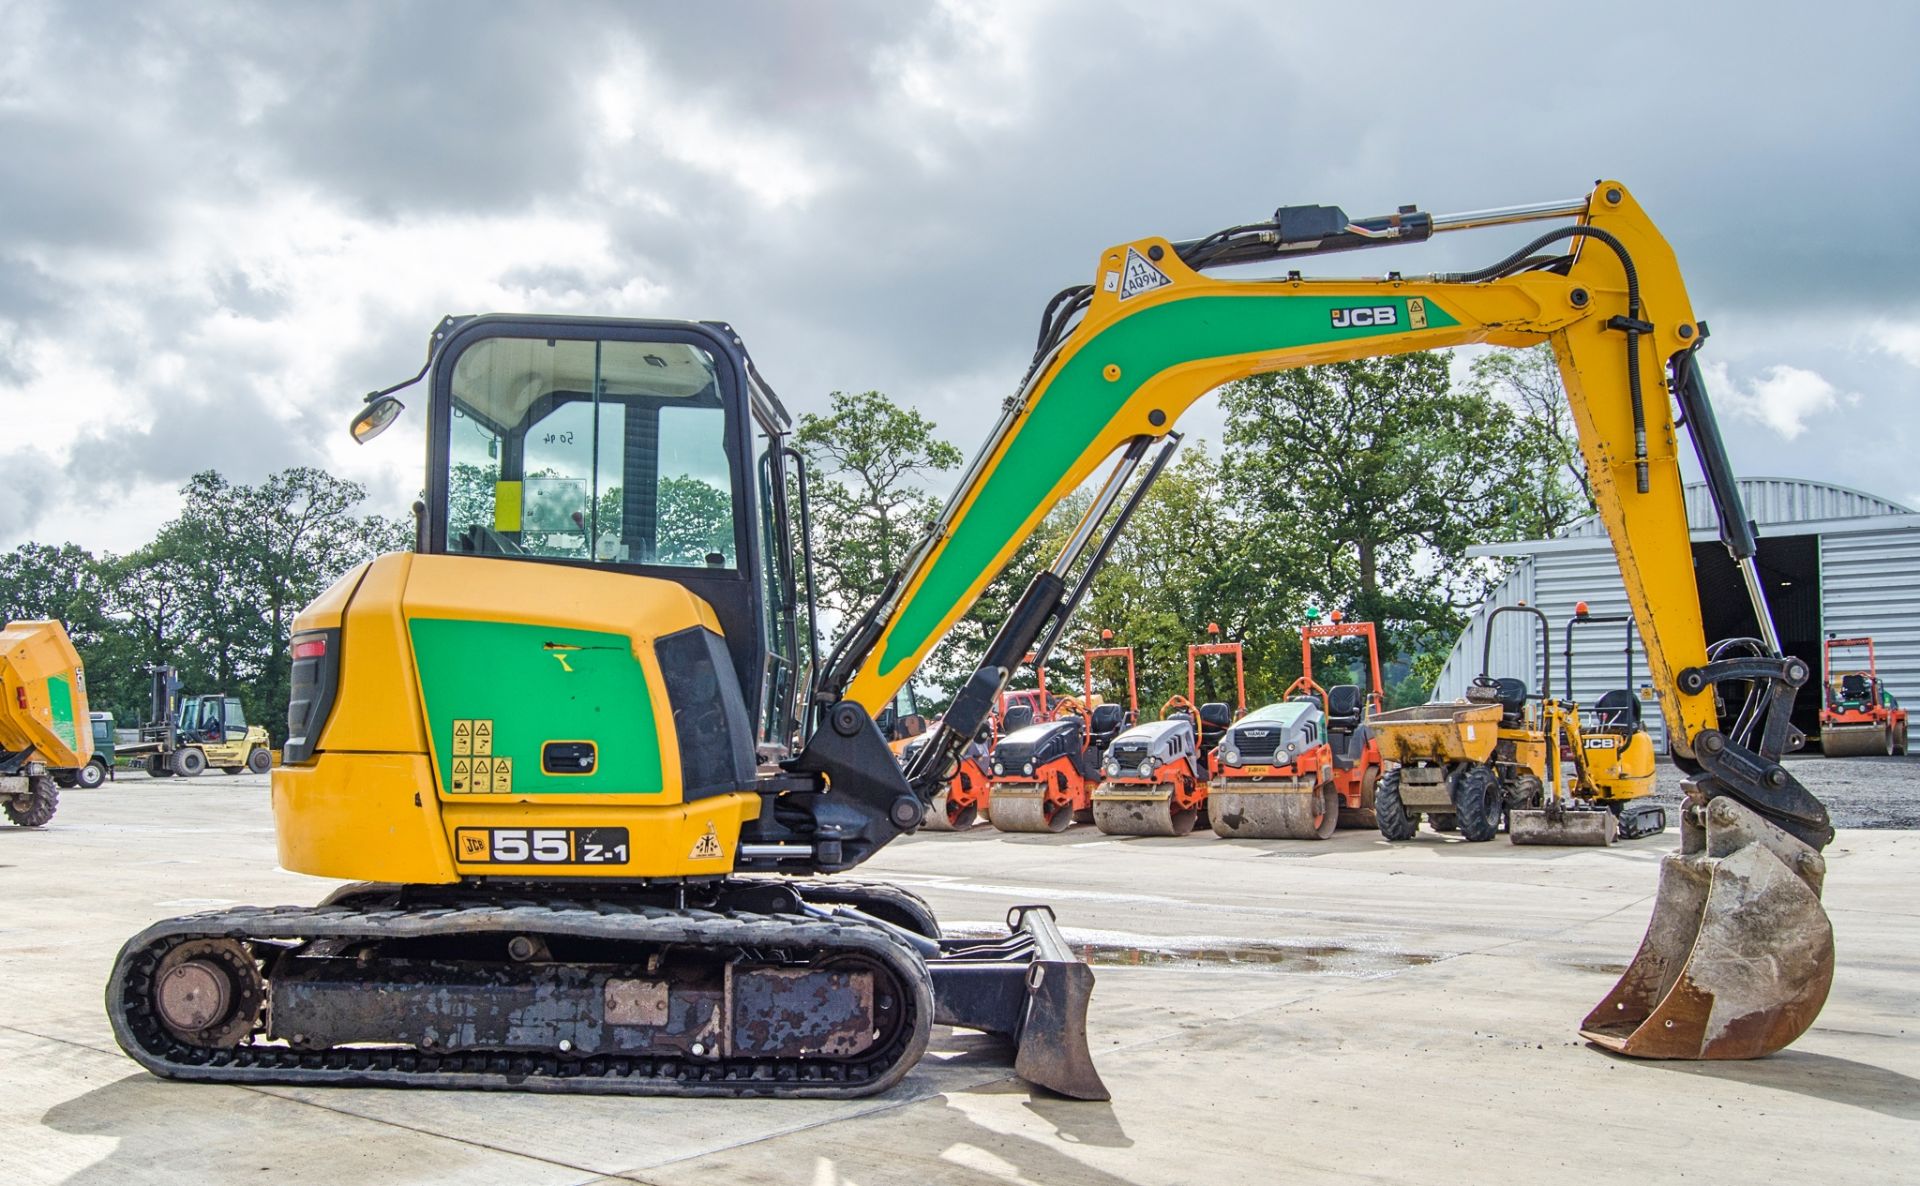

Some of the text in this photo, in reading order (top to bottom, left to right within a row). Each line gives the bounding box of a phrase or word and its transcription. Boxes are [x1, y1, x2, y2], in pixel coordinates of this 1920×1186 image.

[1131, 263, 1146, 277] 11
[1128, 271, 1158, 290] AQ9W
[1331, 306, 1396, 328] JCB
[1584, 738, 1615, 749] JCB
[467, 829, 627, 862] JCB 55 Z-1
